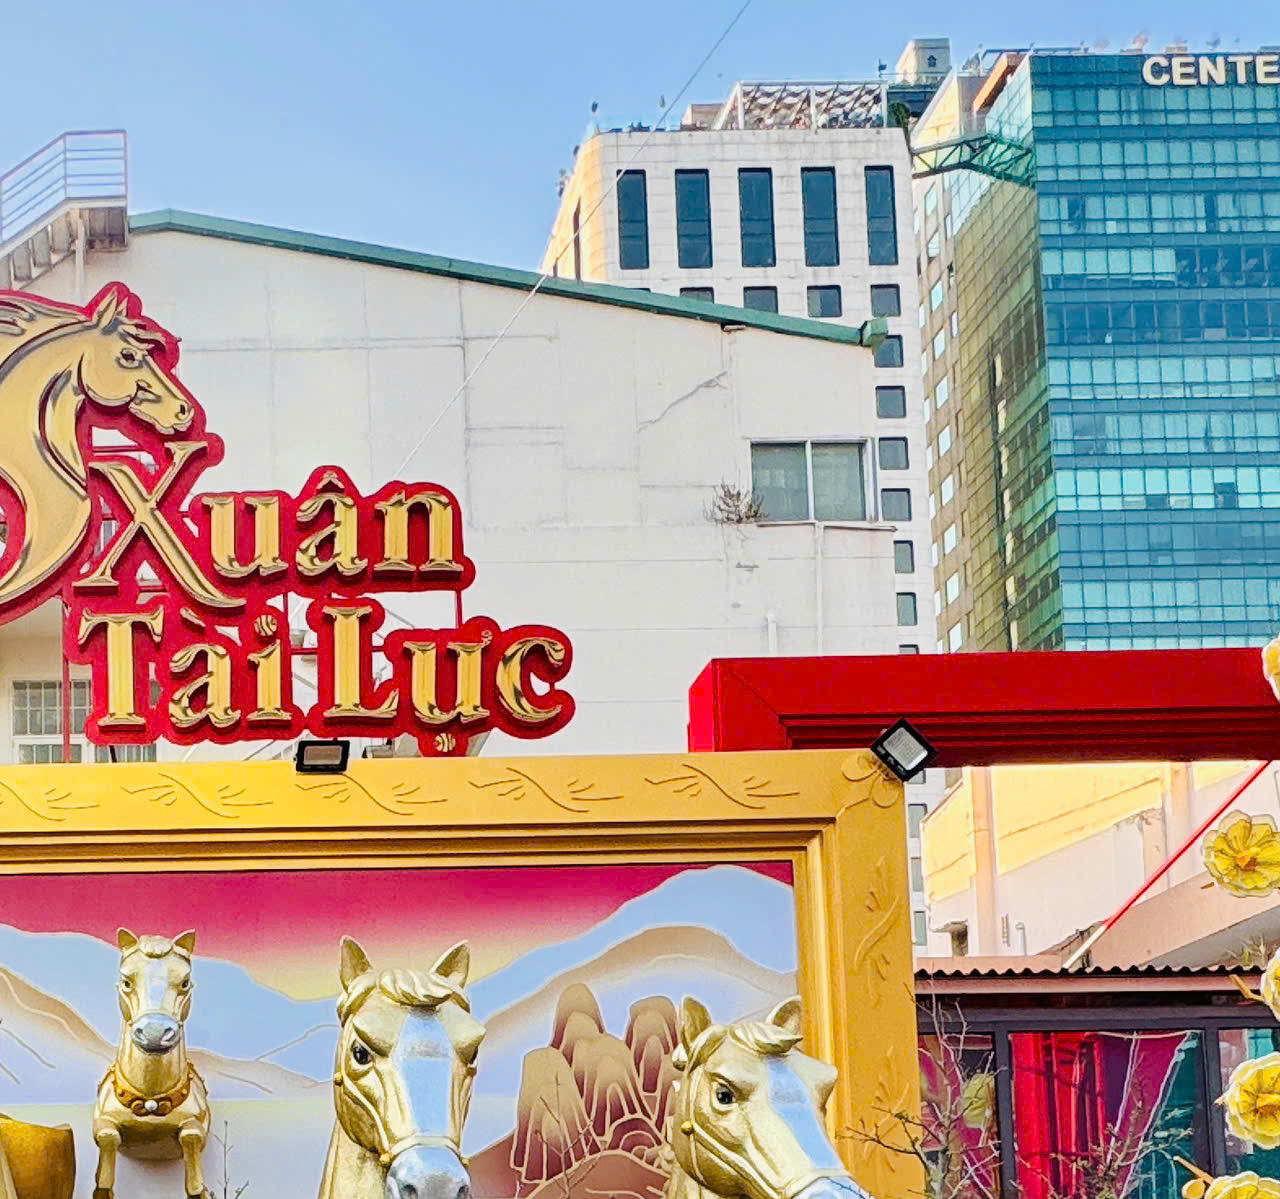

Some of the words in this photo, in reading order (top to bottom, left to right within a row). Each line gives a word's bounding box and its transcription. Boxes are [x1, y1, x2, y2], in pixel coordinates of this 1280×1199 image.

[1142, 55, 1280, 86] CENTE
[73, 441, 465, 608] Xuân
[77, 605, 293, 728] Tài
[322, 604, 566, 754] Lực
